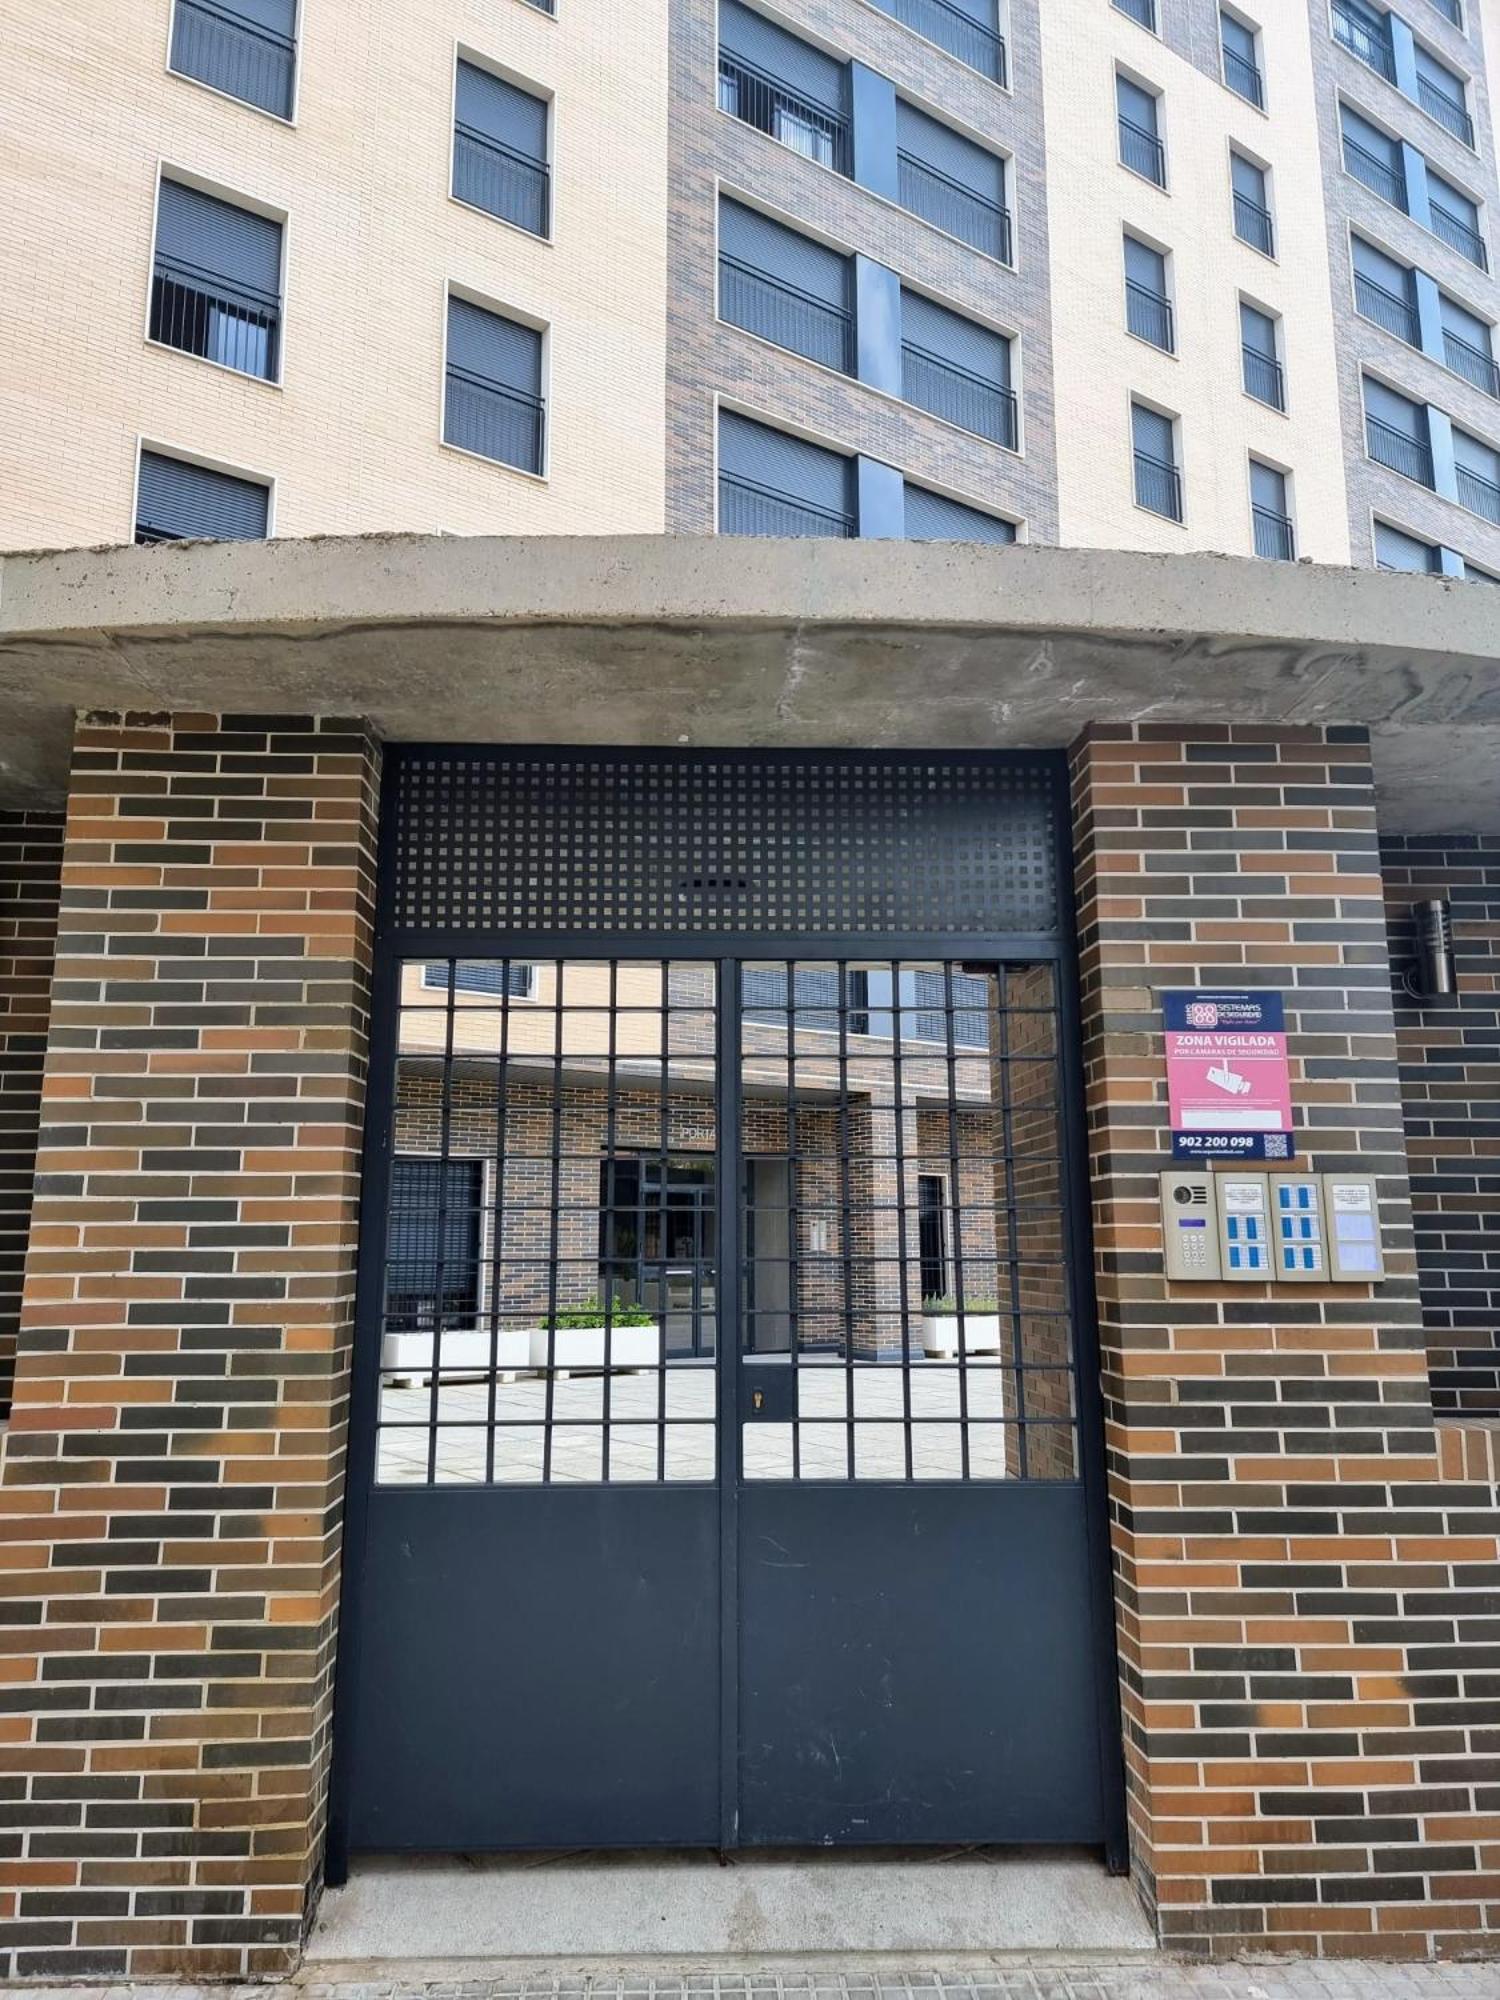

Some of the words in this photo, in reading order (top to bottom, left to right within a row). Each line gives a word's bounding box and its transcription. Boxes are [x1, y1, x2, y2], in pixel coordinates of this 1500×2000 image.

[1176, 1035, 1211, 1046] ZONA
[1214, 1035, 1275, 1046] VIGILADA
[1238, 1048, 1279, 1056] SEGURIDAD
[682, 1127, 716, 1140] PORTA
[1178, 1136, 1203, 1147] 902
[1204, 1136, 1228, 1147] 200
[1230, 1136, 1254, 1147] 098
